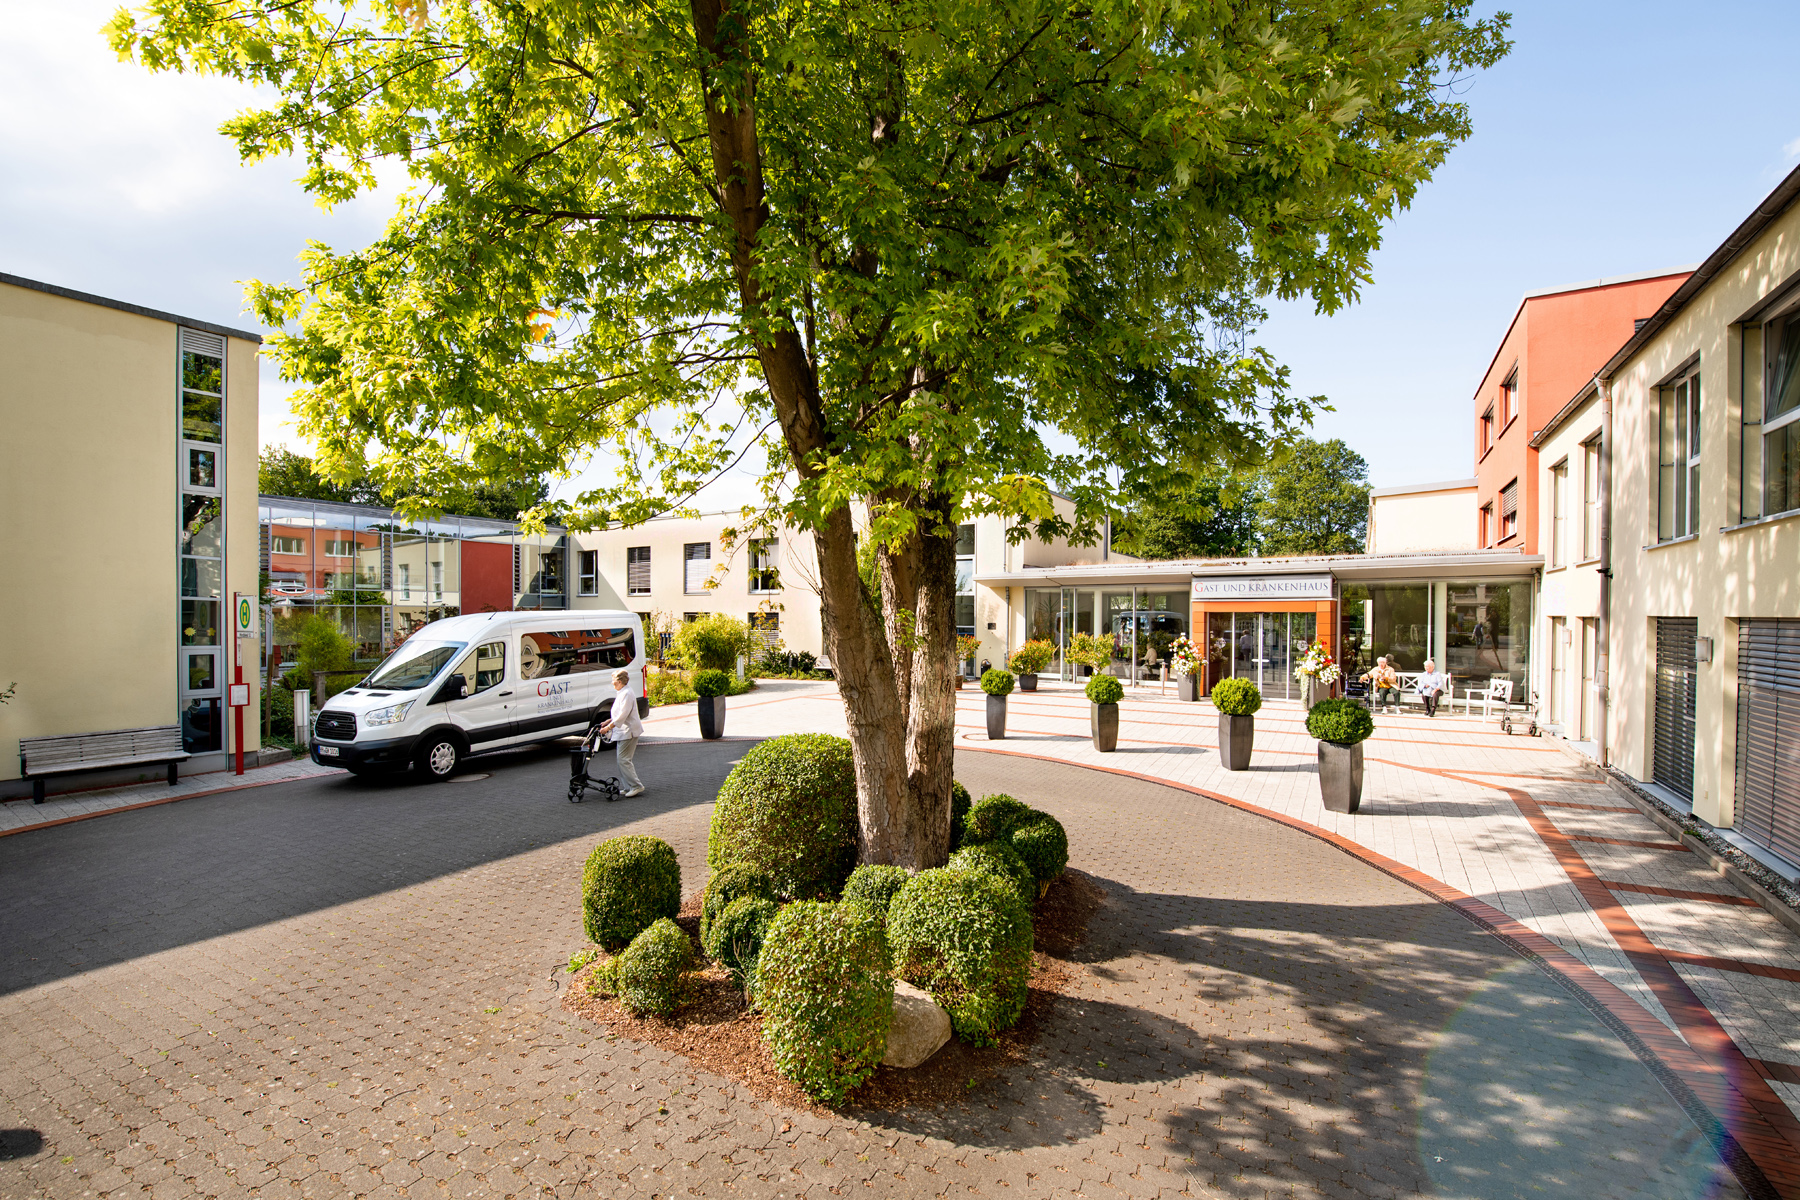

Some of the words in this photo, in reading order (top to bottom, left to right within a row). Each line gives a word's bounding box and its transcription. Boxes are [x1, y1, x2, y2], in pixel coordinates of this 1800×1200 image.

[1223, 583, 1246, 592] UND
[1249, 582, 1329, 592] KRANKENHAUS
[537, 698, 574, 709] KRANKENHAUS
